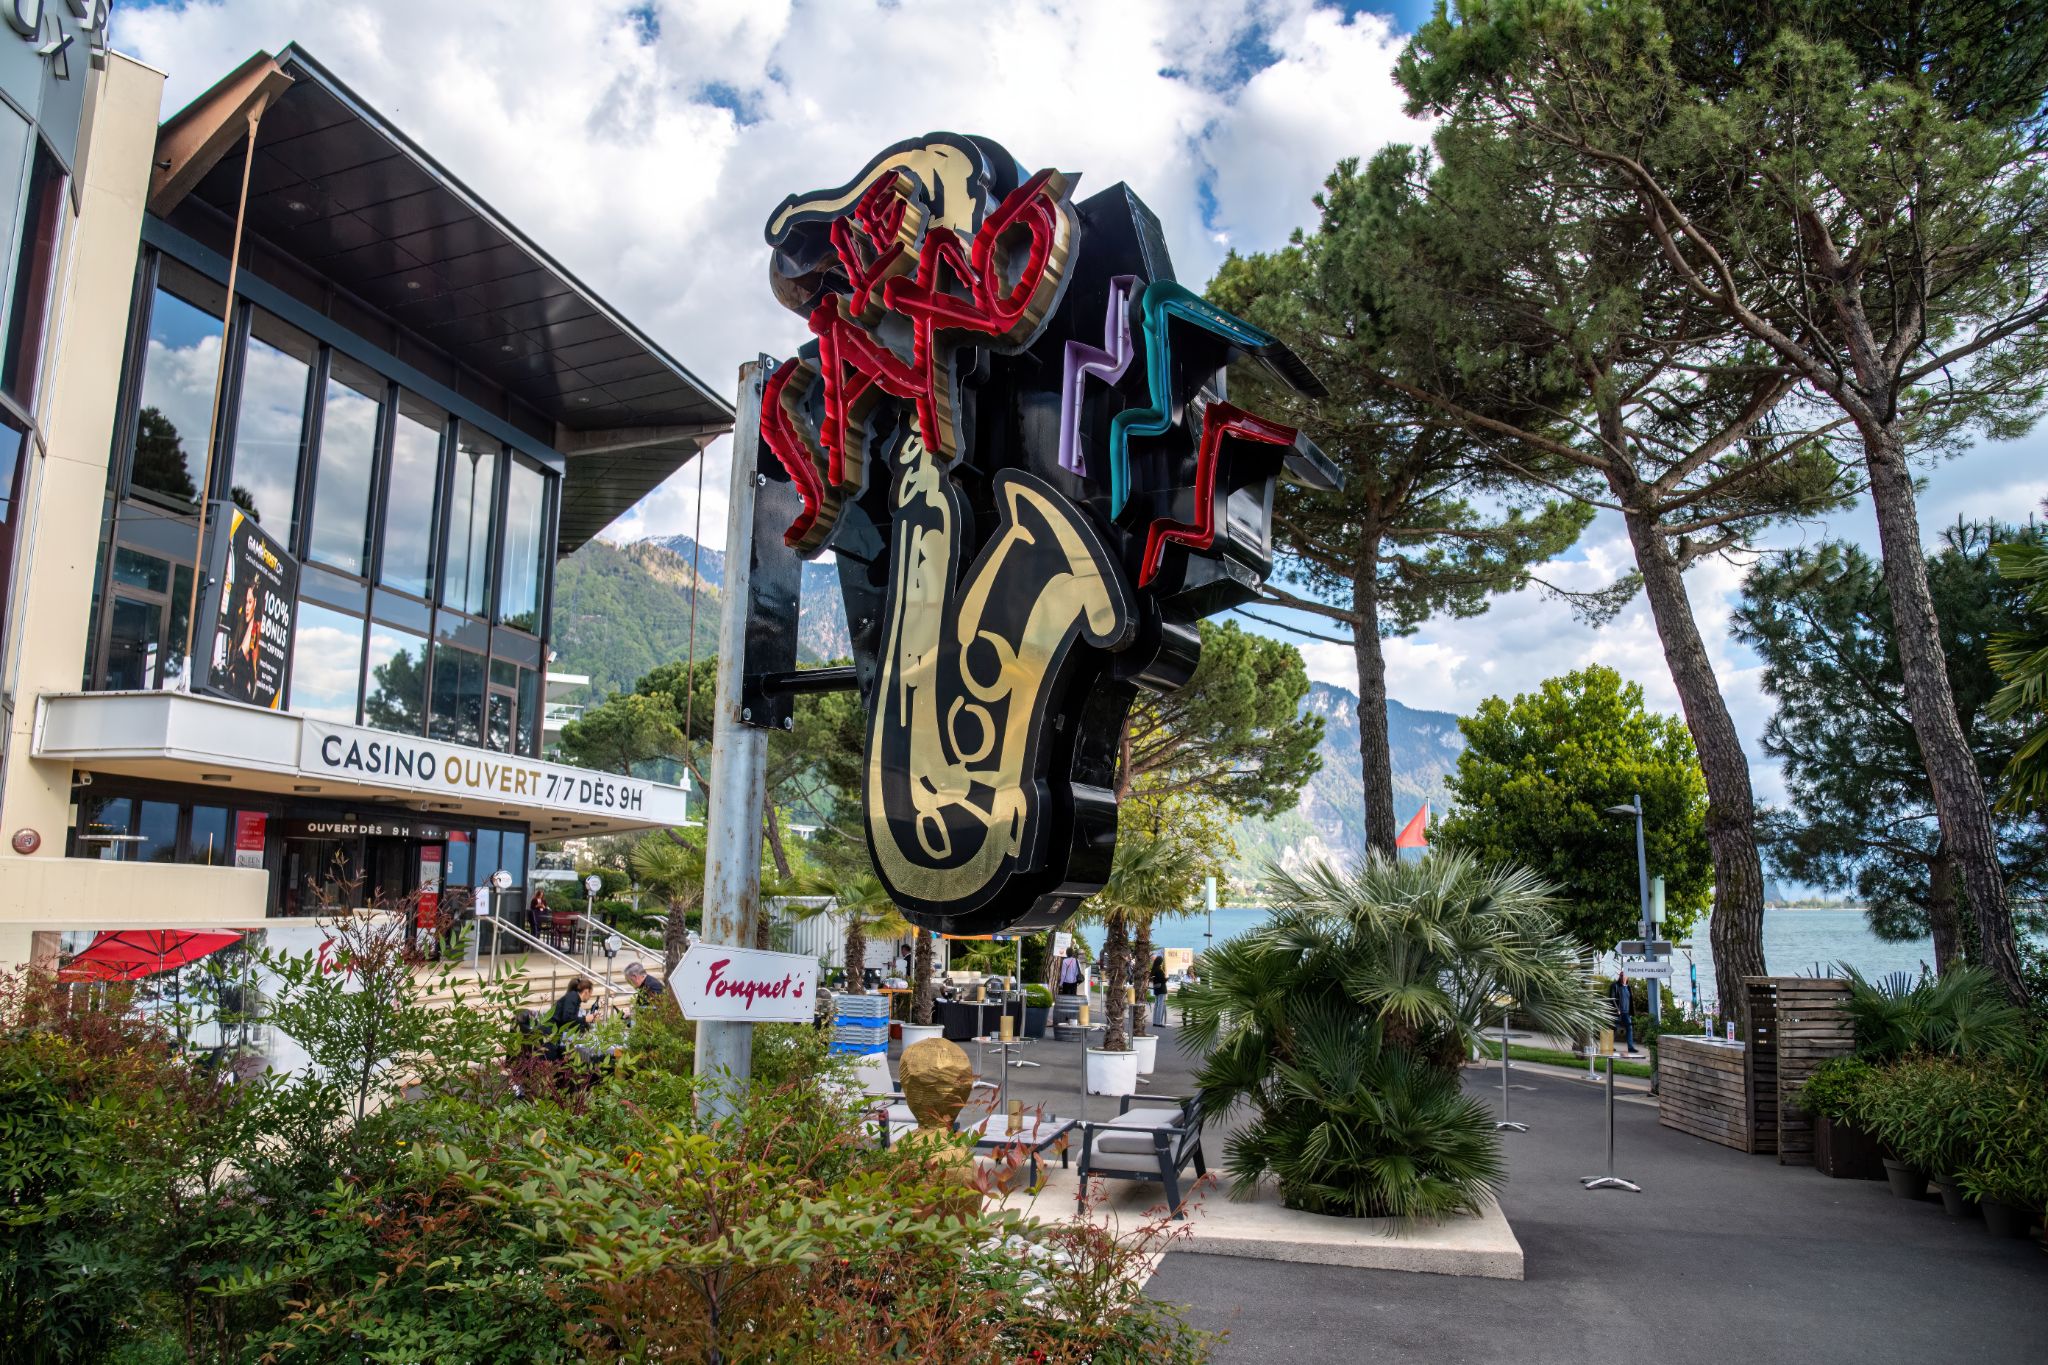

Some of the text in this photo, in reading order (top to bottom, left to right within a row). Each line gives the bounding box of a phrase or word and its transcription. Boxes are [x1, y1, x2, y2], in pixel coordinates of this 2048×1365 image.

[760, 166, 1060, 550] SAXO
[261, 614, 287, 648] BONUS
[264, 590, 289, 627] 100%
[321, 735, 436, 781] CASINO
[444, 756, 542, 797] OUVERT
[546, 774, 576, 803] 7/7
[579, 777, 615, 808] DÈS
[307, 823, 358, 834] OUVERT
[704, 958, 805, 1011] Fouquet's
